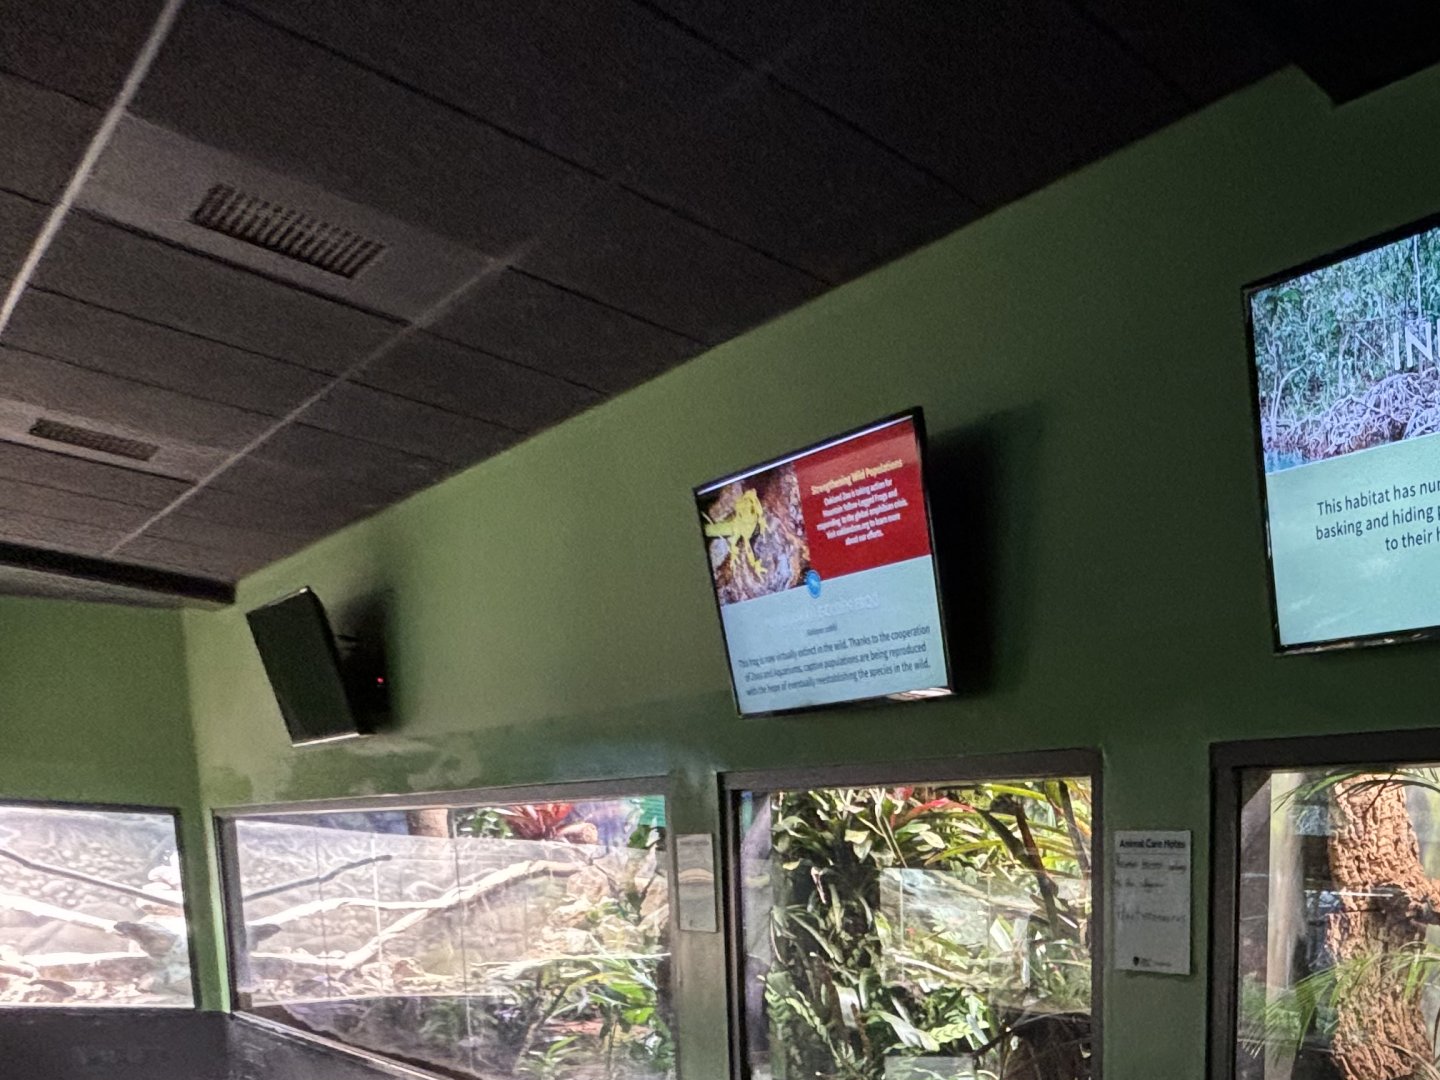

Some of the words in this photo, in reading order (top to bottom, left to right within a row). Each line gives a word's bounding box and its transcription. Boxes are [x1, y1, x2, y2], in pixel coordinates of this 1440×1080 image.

[1317, 498, 1342, 516] This
[1345, 489, 1390, 511] habitat
[1393, 484, 1416, 500] has
[1316, 521, 1362, 541] basking
[1366, 512, 1389, 531] and
[1393, 505, 1434, 523] hiding
[1385, 537, 1398, 551] to
[1402, 529, 1433, 549] their
[848, 634, 871, 647] Thanks
[871, 635, 879, 643] to
[879, 631, 890, 641] the
[891, 624, 930, 640] cooperation
[893, 663, 900, 671] in
[901, 661, 912, 671] the
